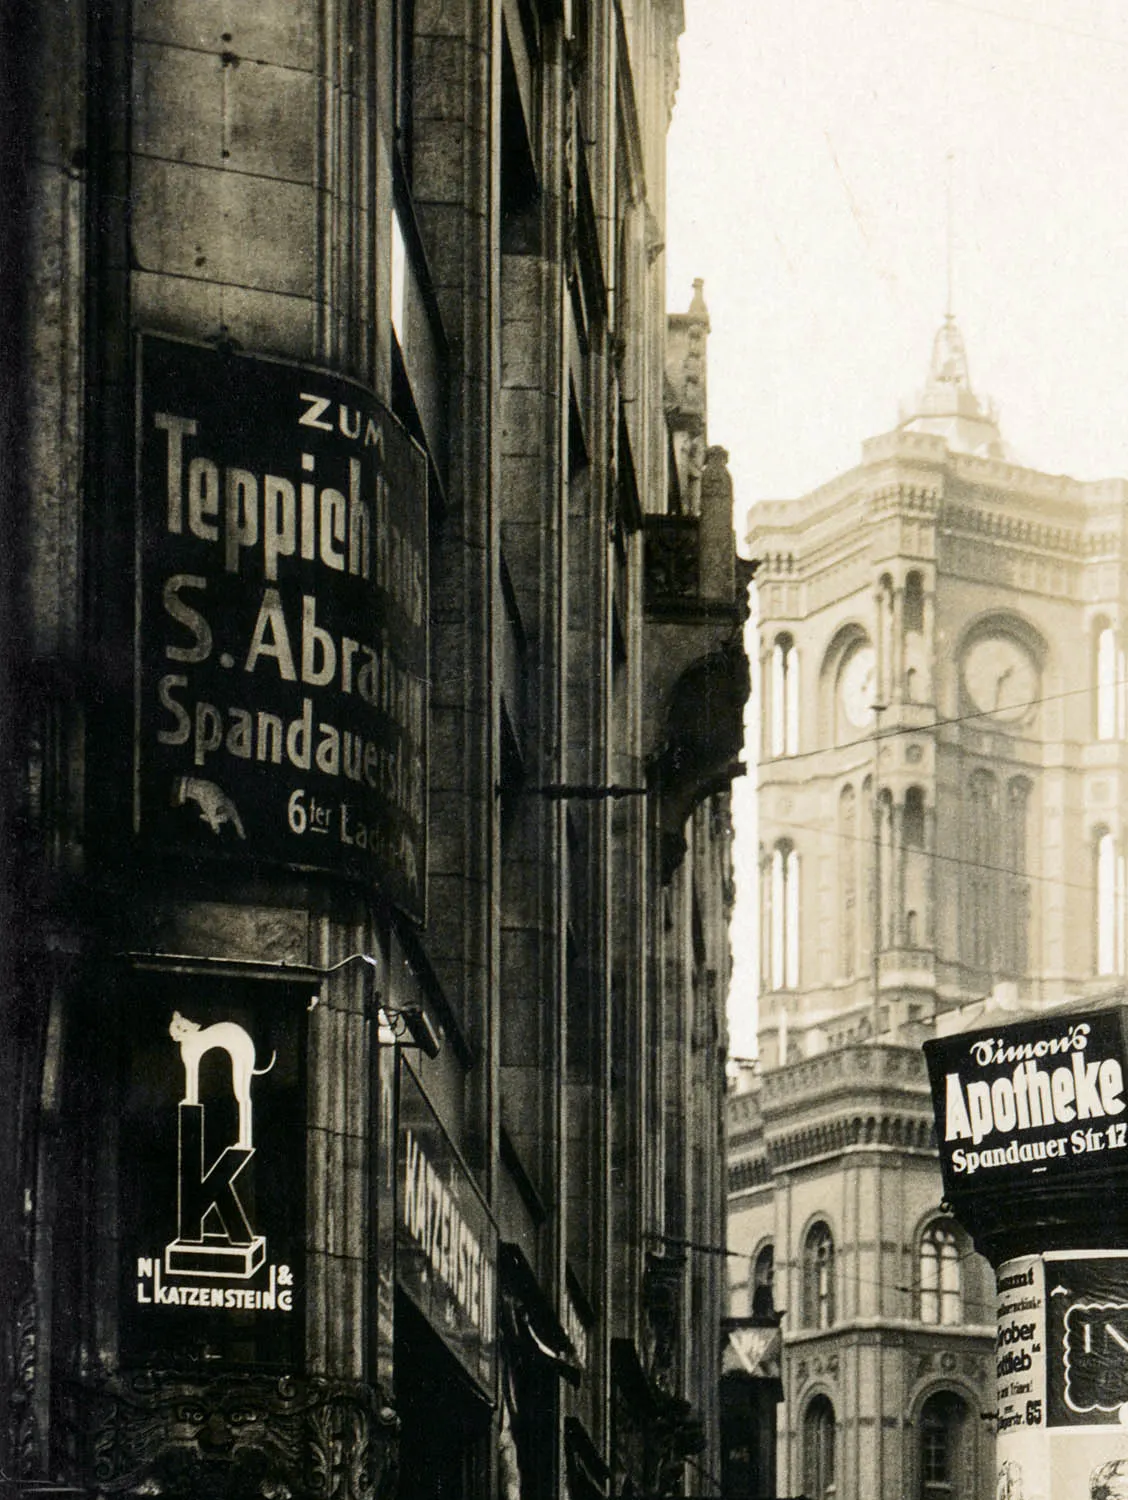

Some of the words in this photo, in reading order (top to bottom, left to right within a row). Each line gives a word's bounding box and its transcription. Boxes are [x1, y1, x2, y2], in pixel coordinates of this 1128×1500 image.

[299, 391, 385, 462] ZUM
[154, 411, 371, 582] Teppich
[163, 573, 236, 669] S.
[945, 1051, 1128, 1145] Apotheke
[951, 1136, 1068, 1174] Spandauer
[1104, 1122, 1128, 1149] 17
[137, 1256, 153, 1278] N
[277, 1264, 294, 1286] &
[137, 1282, 152, 1303] L
[154, 1257, 276, 1311] KATZENSTEIN
